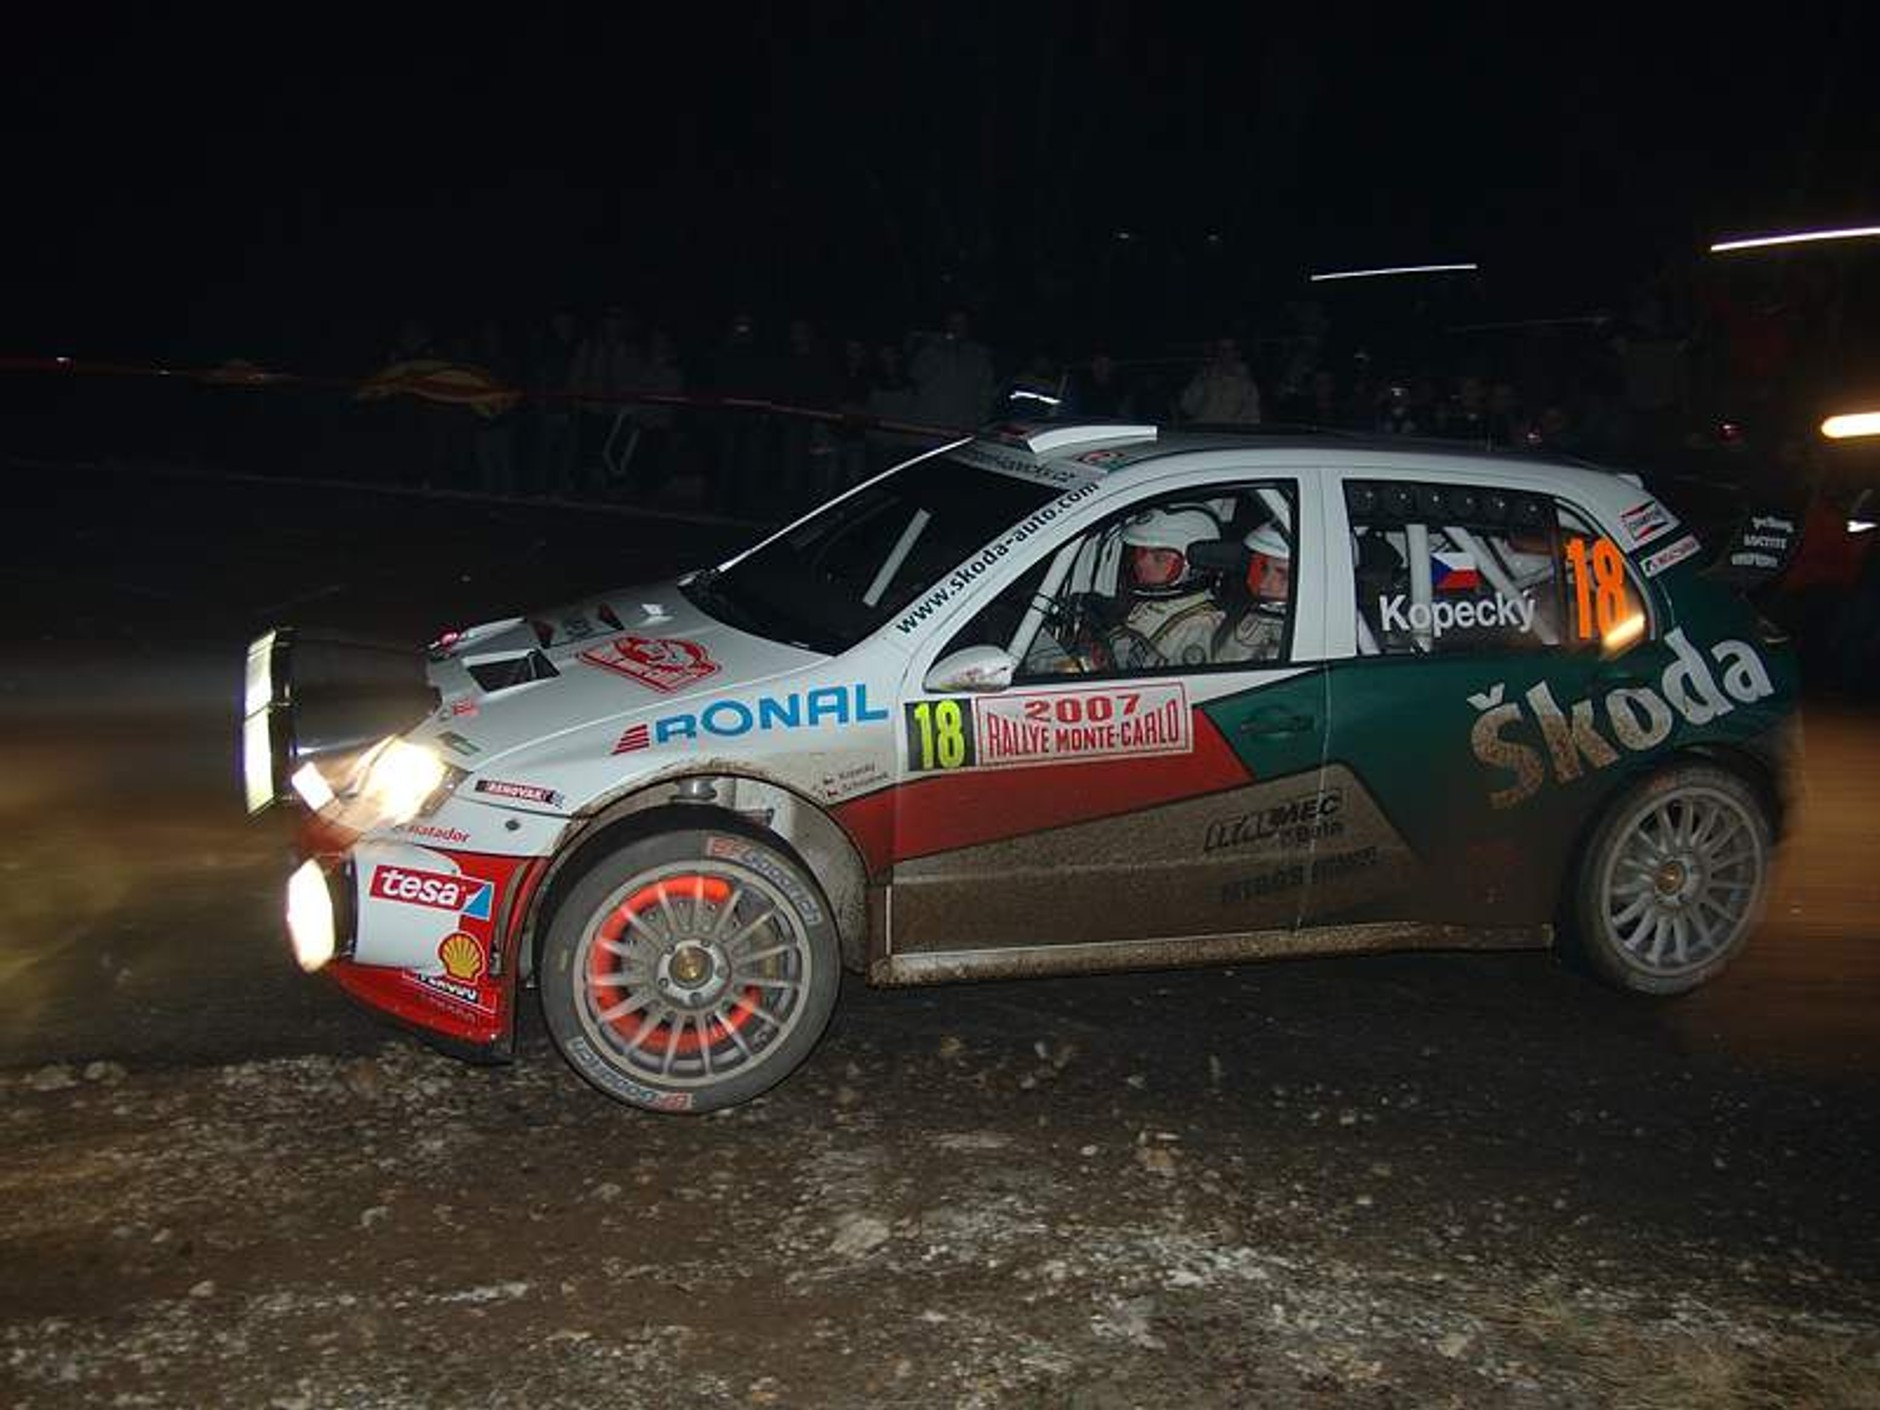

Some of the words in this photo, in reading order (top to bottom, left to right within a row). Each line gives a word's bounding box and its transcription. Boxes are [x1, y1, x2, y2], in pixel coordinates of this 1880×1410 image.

[896, 481, 1100, 635] www.skoda-auto.com
[1378, 589, 1536, 637] Kopecký
[1565, 536, 1627, 642] 18
[655, 683, 889, 744] RONAL
[913, 700, 966, 770] 18
[986, 710, 1050, 758] RALLYE
[1024, 693, 1142, 724] 2007
[1466, 625, 1775, 810] Škoda
[380, 869, 460, 907] tesa
